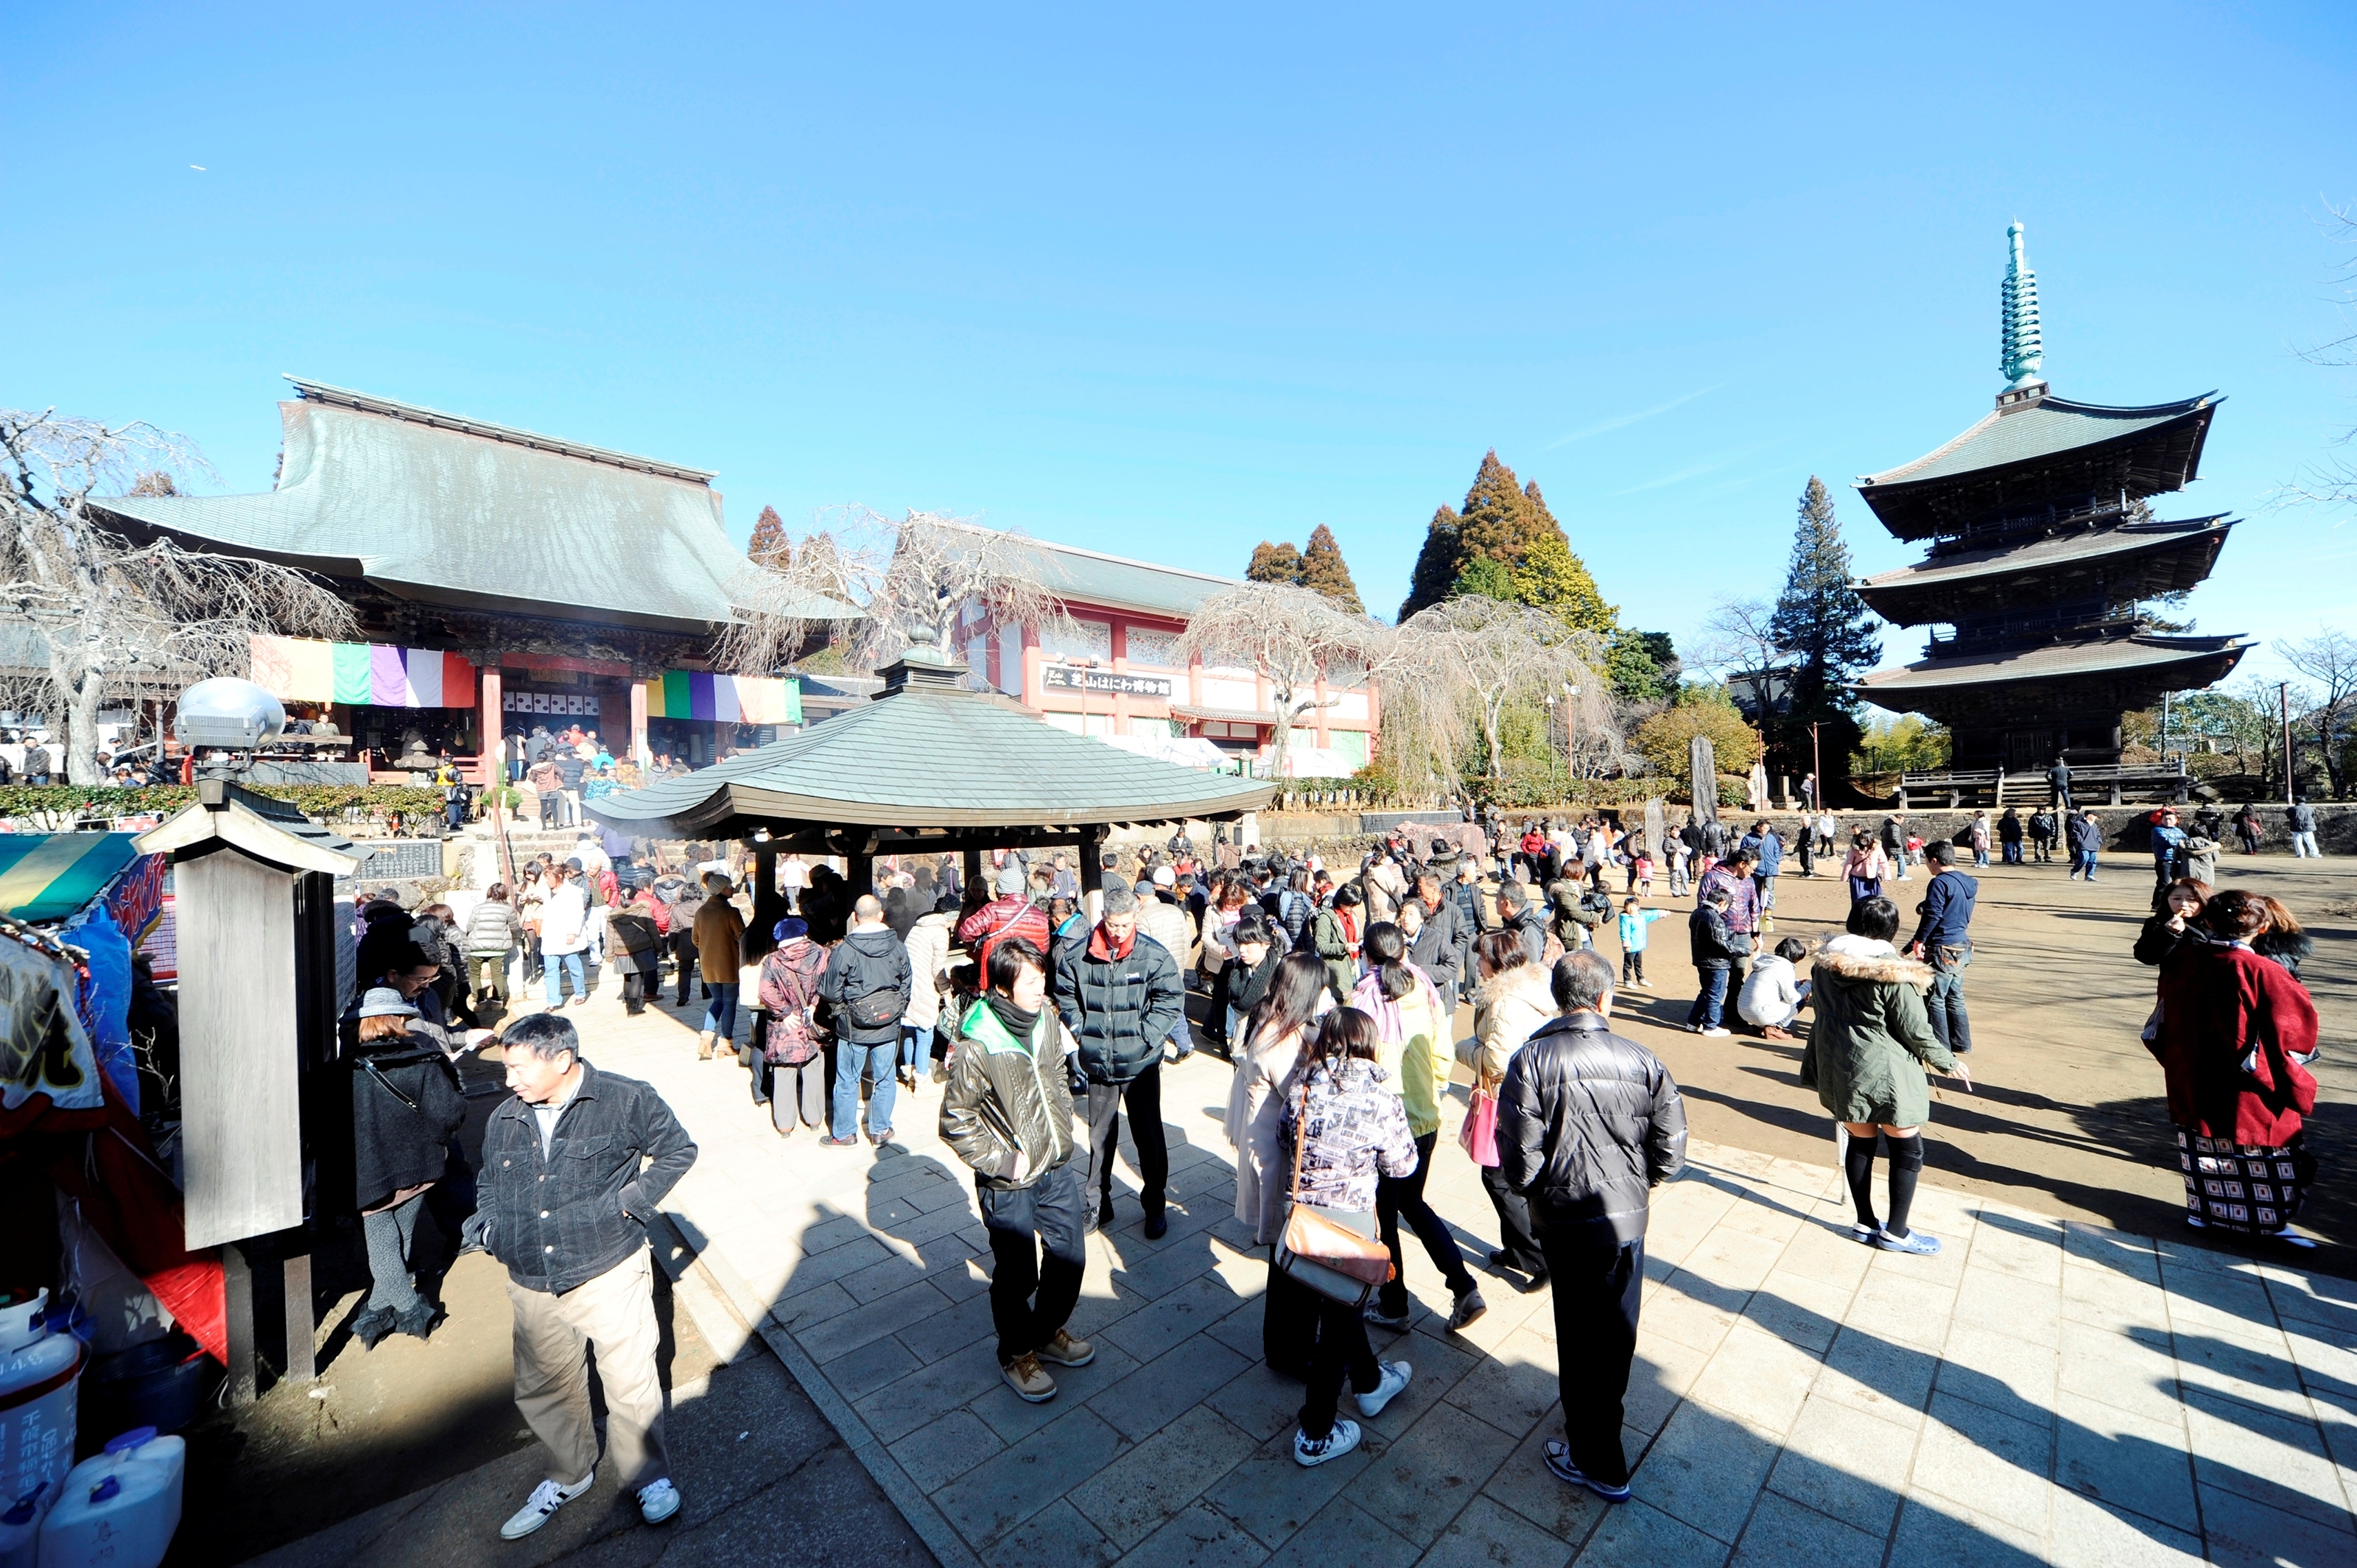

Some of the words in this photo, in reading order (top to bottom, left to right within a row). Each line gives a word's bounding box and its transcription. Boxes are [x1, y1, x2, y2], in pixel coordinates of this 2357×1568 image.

[1071, 673, 1170, 695] 芝山はにわ博物館
[1340, 1128, 1355, 1139] LOOK
[1355, 1133, 1369, 1144] OVER
